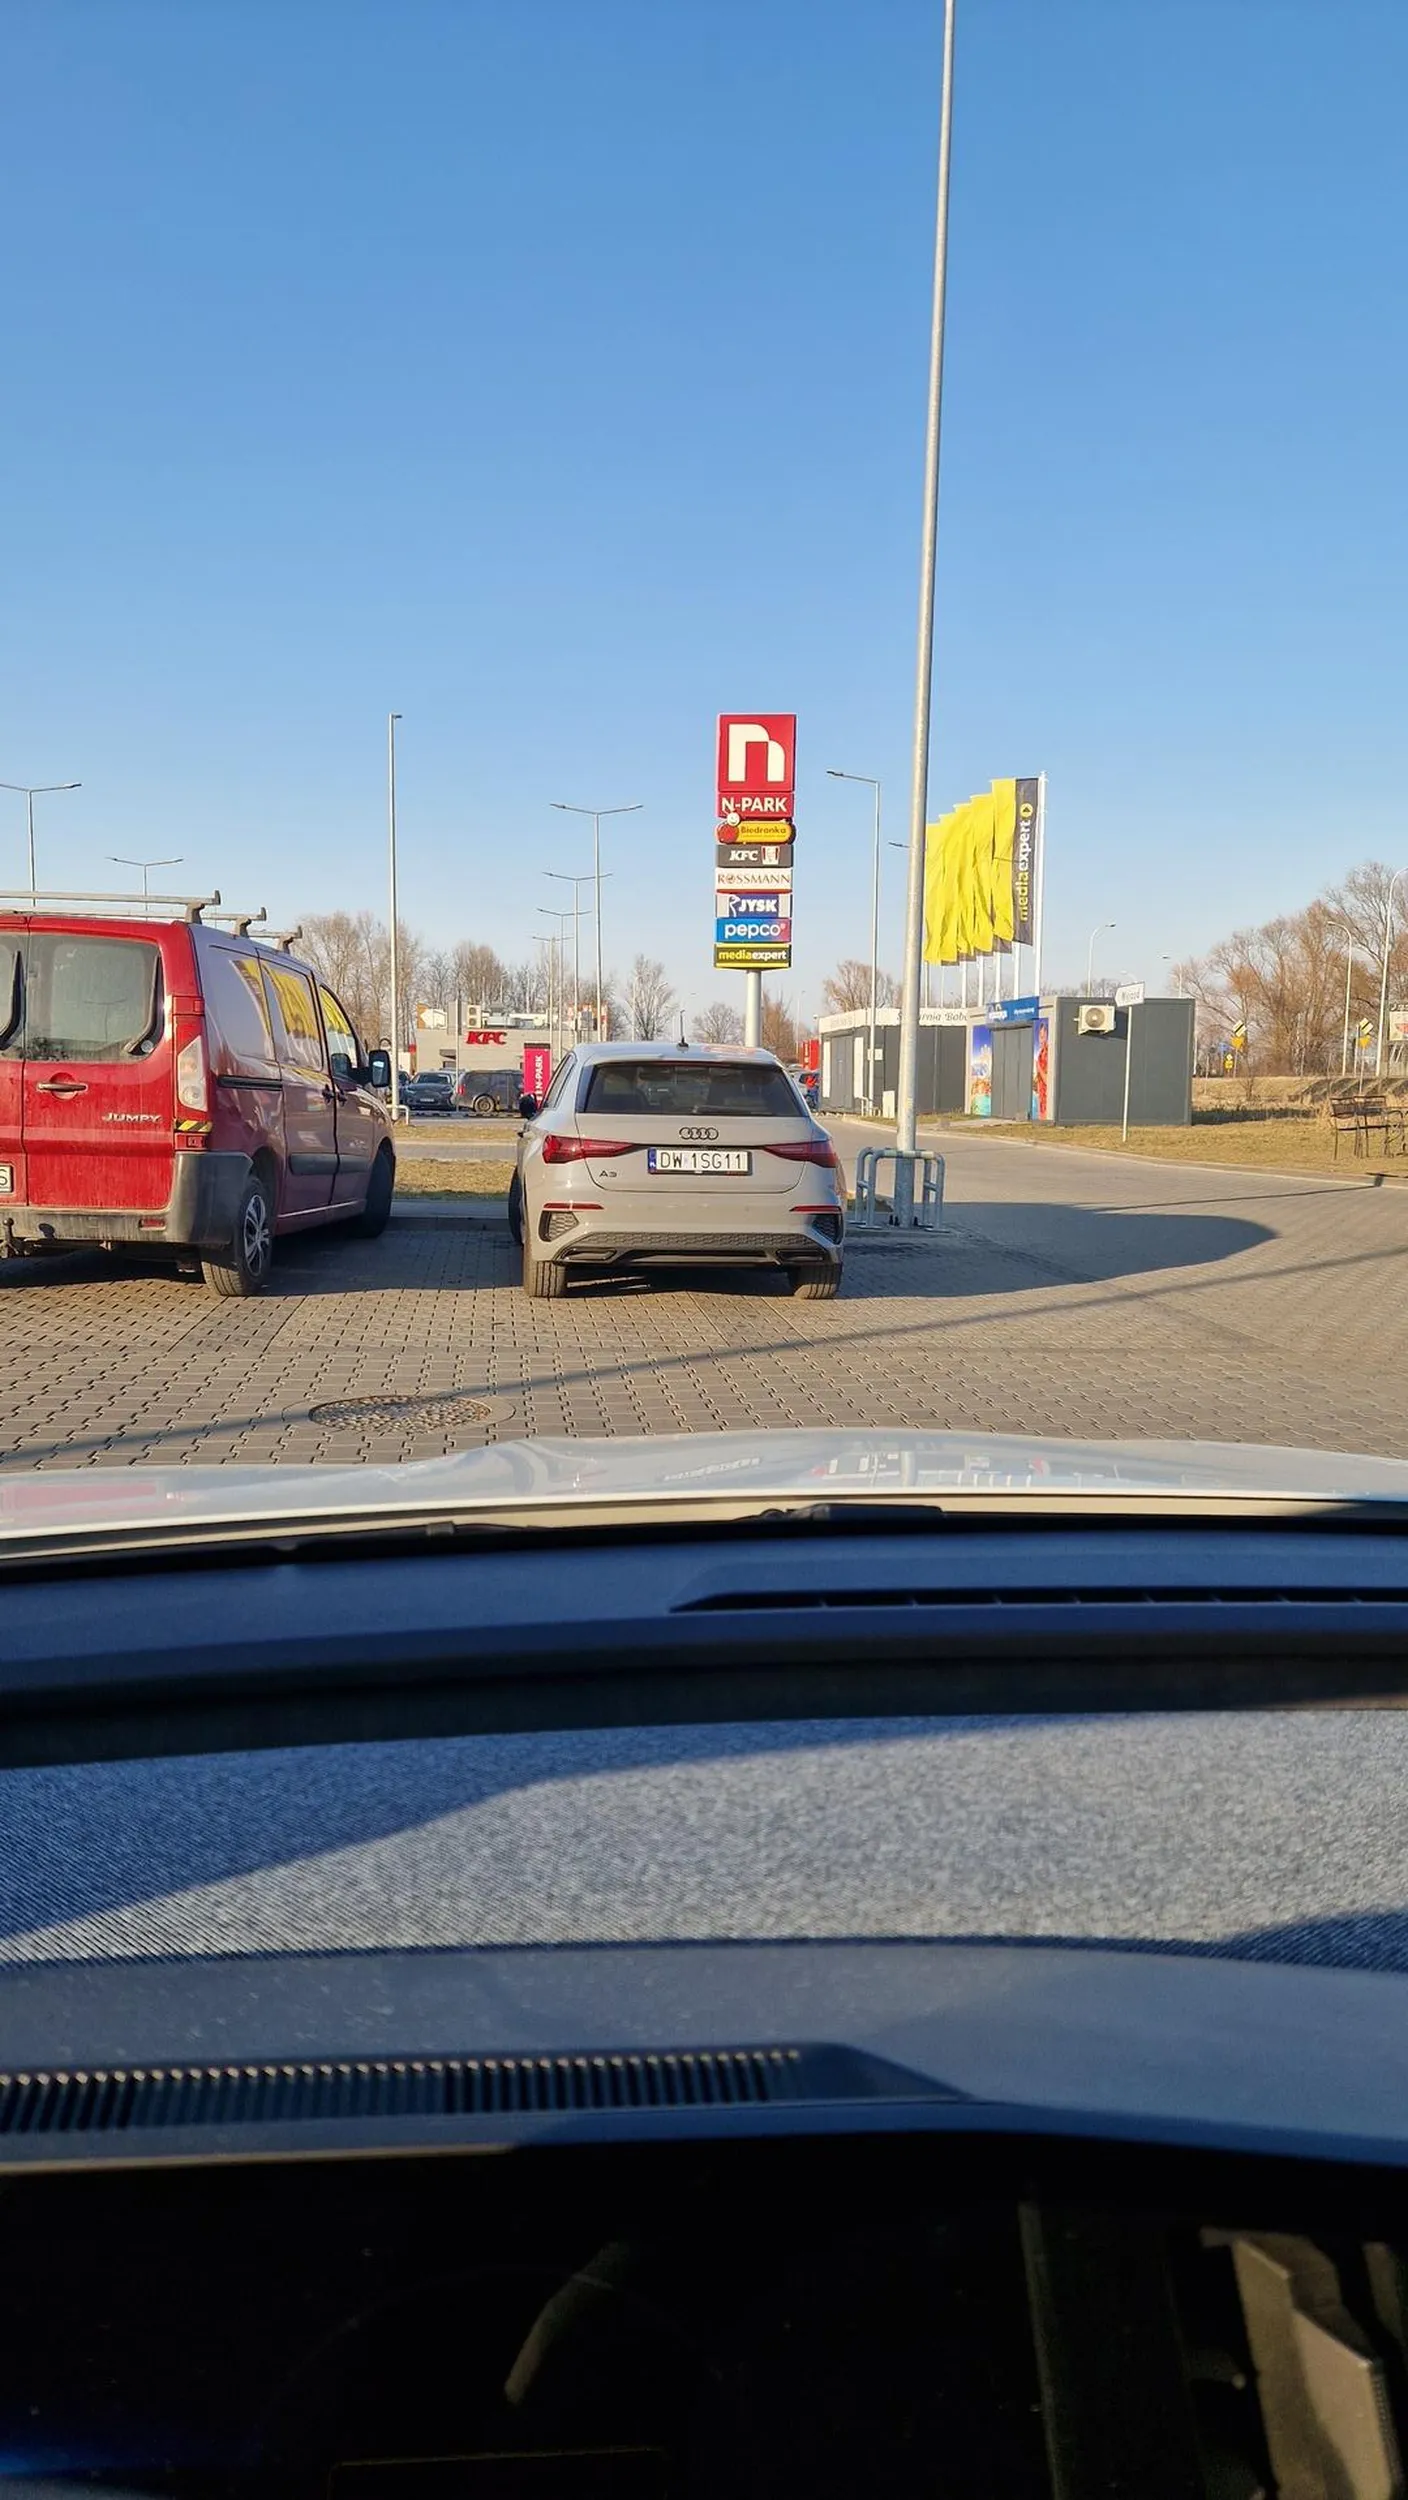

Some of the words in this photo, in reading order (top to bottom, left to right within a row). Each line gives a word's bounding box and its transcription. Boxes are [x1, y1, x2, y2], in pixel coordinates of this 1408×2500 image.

[721, 797, 788, 813] N-PARK
[729, 849, 759, 862] KFC
[1014, 819, 1032, 922] mediaexpert
[717, 873, 790, 884] ROSSMANN
[738, 898, 778, 913] JYSK
[724, 922, 782, 940] pepco
[718, 950, 787, 963] mediaexpert
[466, 1030, 508, 1045] KFC
[103, 1112, 162, 1123] JUMPY
[660, 1152, 683, 1168] DW
[691, 1152, 742, 1169] 1SG11
[599, 1170, 617, 1178] A3
